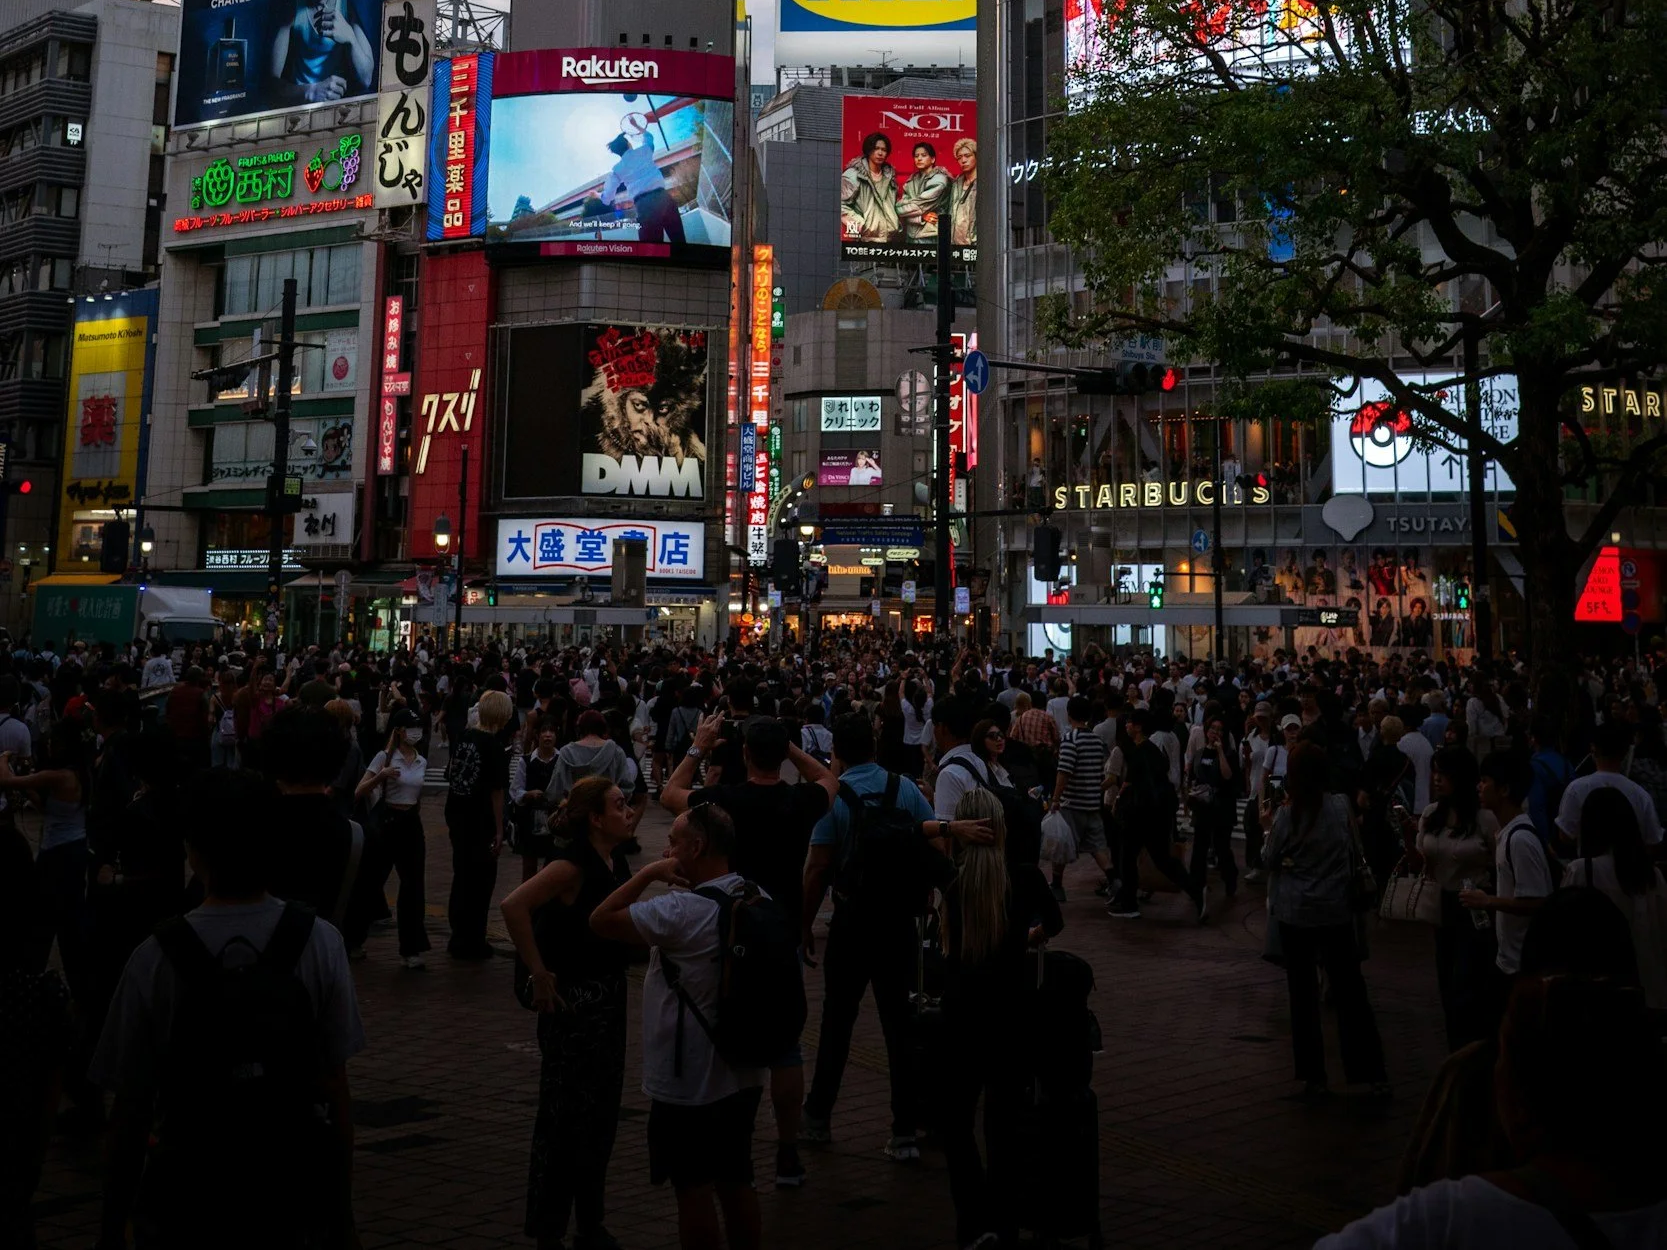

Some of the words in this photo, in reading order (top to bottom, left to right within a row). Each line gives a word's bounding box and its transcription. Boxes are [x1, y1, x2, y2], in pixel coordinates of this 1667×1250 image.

[562, 54, 659, 82] Rakuten
[378, 1, 430, 200] もんじゃ
[442, 63, 471, 228] 三千里薬品
[238, 151, 296, 168] FRUITS&PARLOR
[236, 164, 294, 203] 西村
[569, 220, 583, 228] And
[599, 220, 614, 229] keep
[616, 220, 621, 228] it
[577, 244, 608, 252] Rakuten
[608, 244, 633, 252] Vision
[78, 331, 117, 342] Matsumoto
[838, 400, 880, 414] れいわ
[1581, 387, 1661, 417] STAR
[81, 395, 118, 447] 薬
[824, 417, 879, 429] クリニック
[581, 452, 704, 498] DMM
[240, 553, 294, 565] フルーツラー
